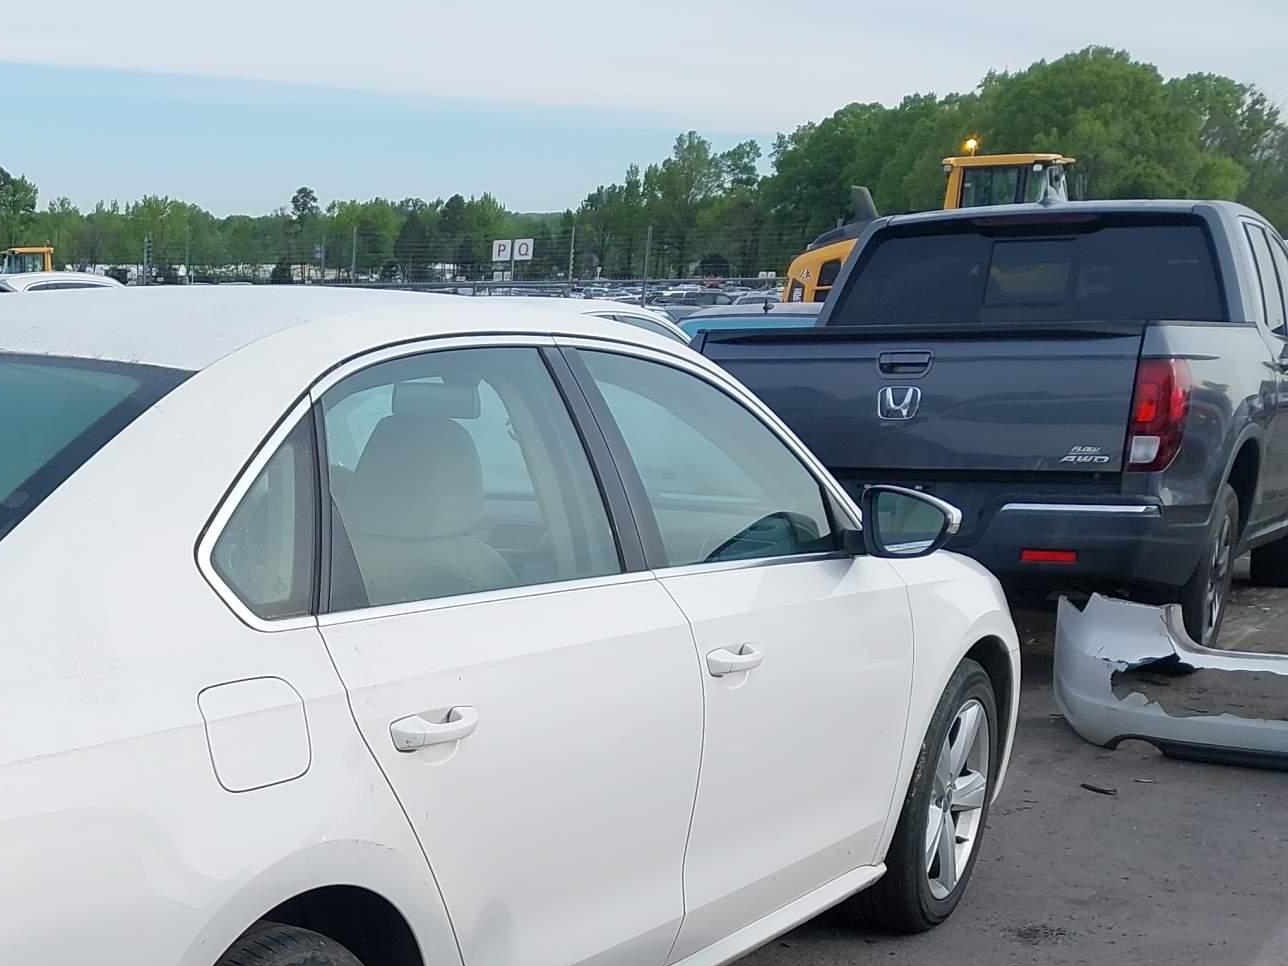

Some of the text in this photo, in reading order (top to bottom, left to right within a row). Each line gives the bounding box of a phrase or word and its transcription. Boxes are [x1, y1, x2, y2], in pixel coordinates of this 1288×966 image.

[497, 243, 507, 257] P
[518, 242, 530, 257] Q
[1059, 455, 1110, 463] AWD
